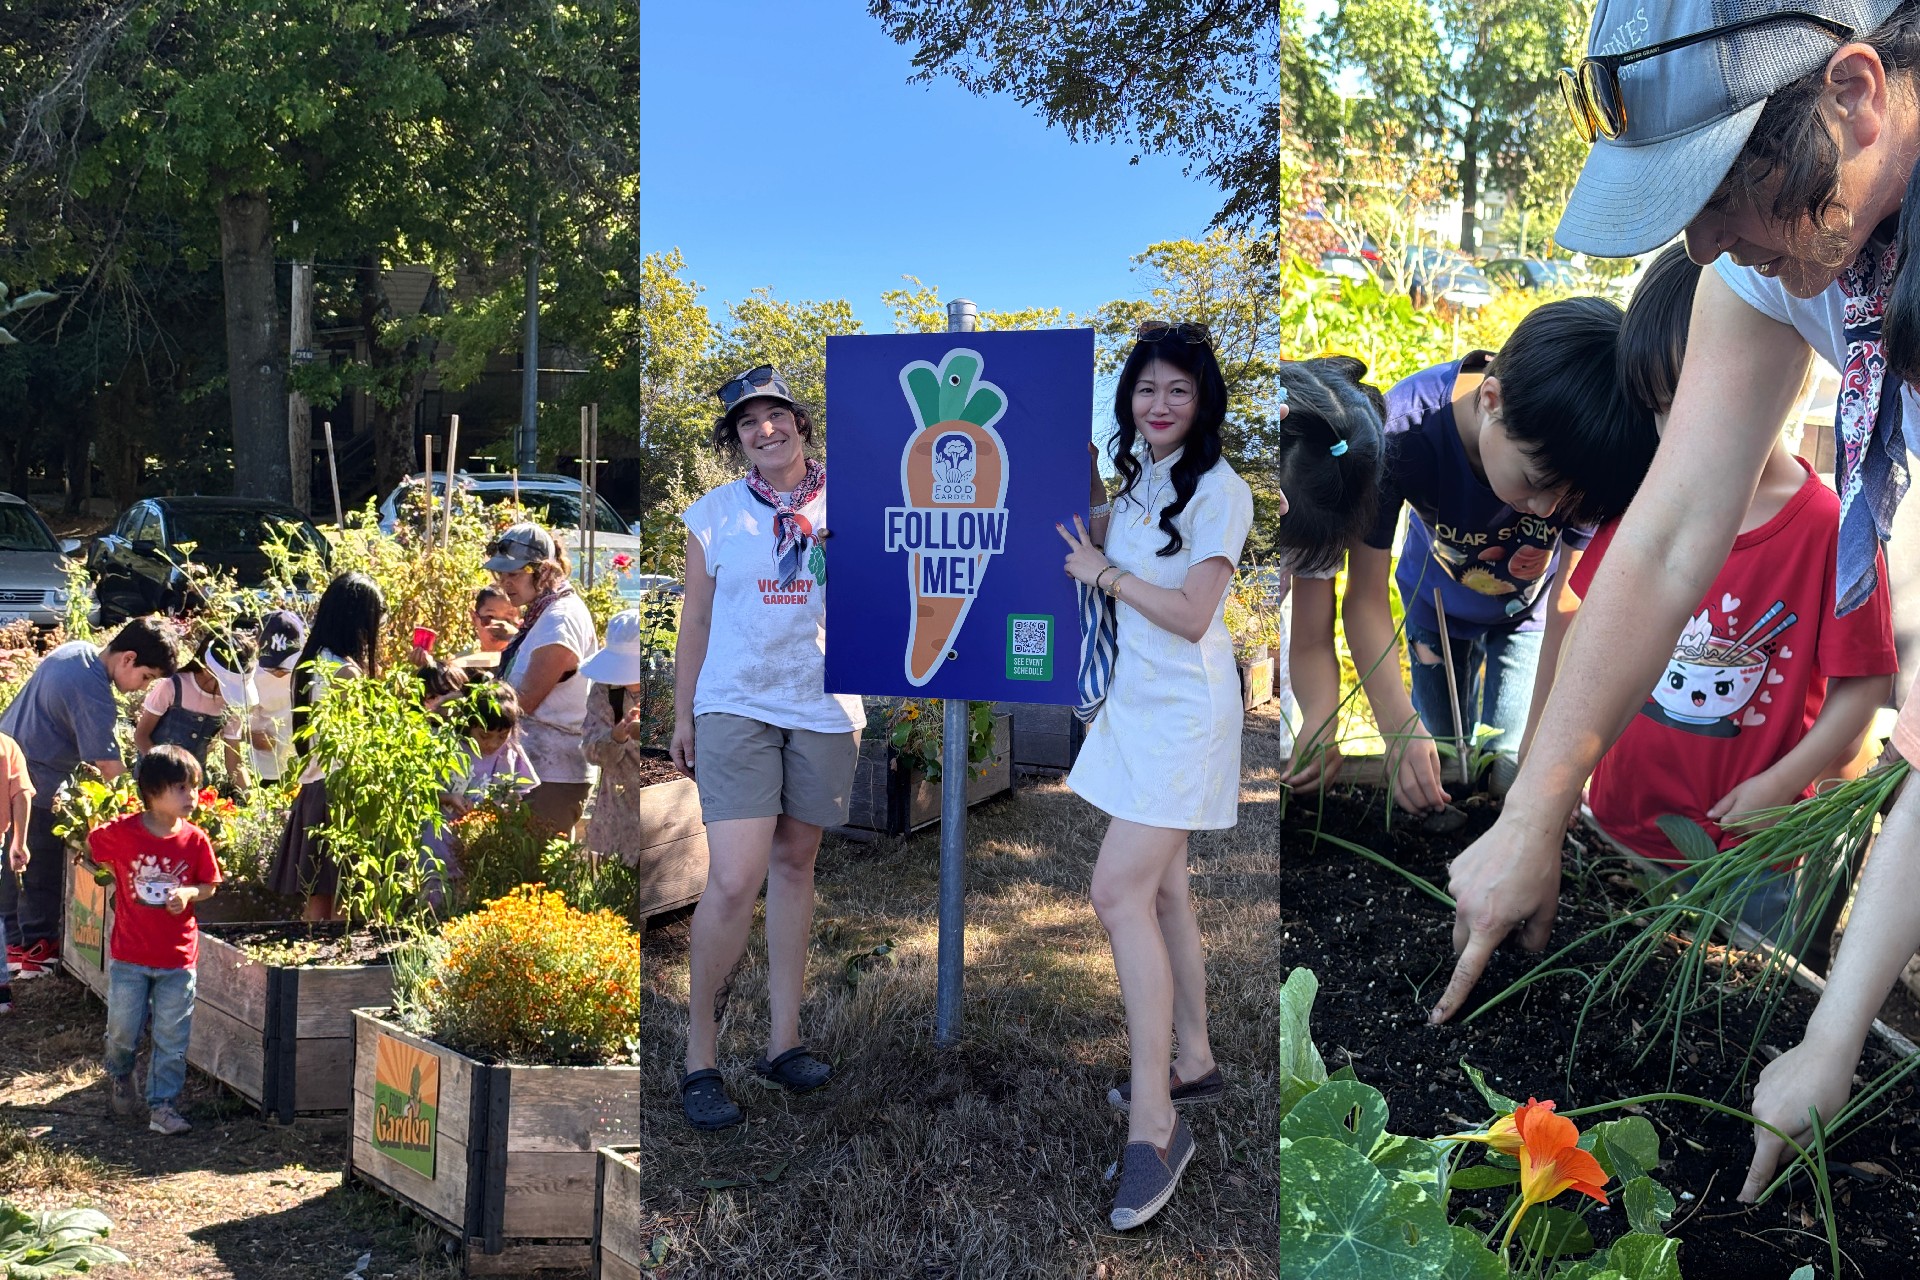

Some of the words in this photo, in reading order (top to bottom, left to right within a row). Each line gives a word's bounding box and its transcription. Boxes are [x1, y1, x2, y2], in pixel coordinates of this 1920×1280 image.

[1642, 46, 1660, 57] GRANT
[935, 485, 973, 494] FOOD
[888, 511, 1005, 550] FOLLOW
[1436, 523, 1488, 546] OLAR
[923, 556, 975, 595] ME!
[762, 594, 808, 605] GARDENS
[271, 633, 287, 651] NY
[1013, 657, 1025, 666] SEE
[1025, 658, 1044, 667] EVENT
[1013, 666, 1044, 676] SCHEDULE
[375, 1103, 431, 1151] Garden
